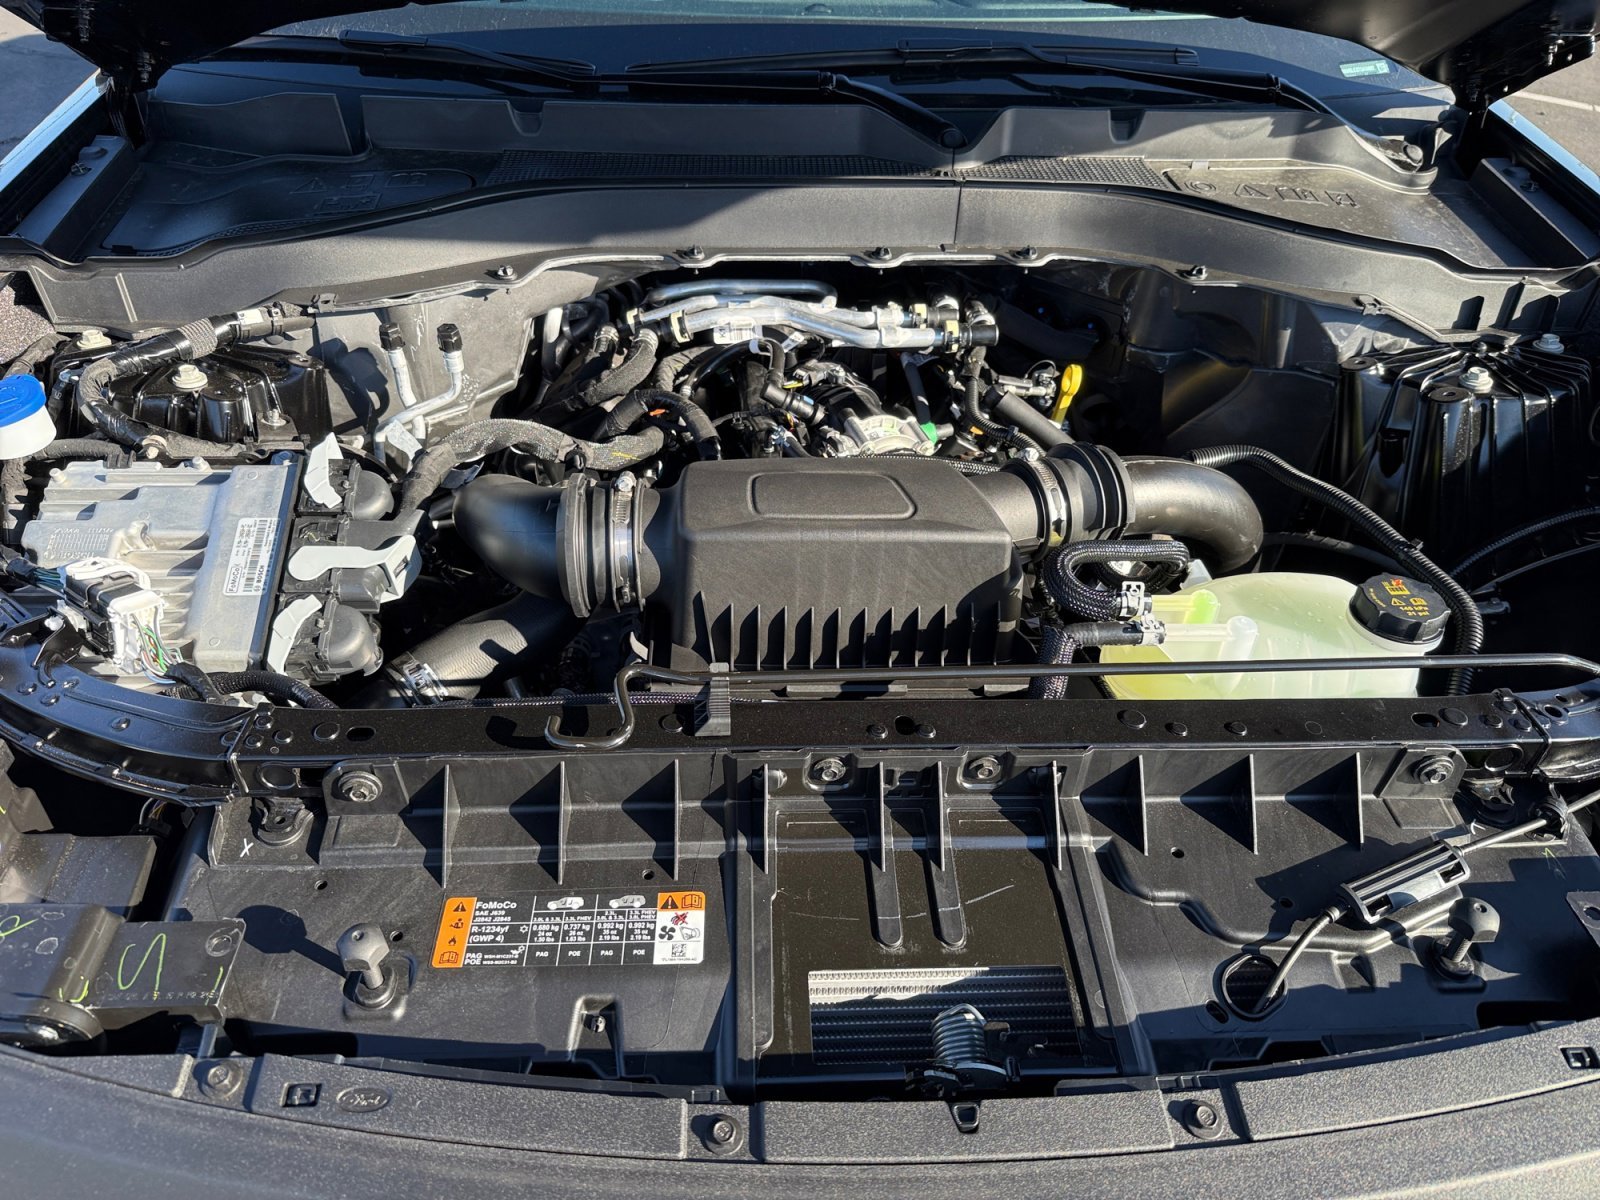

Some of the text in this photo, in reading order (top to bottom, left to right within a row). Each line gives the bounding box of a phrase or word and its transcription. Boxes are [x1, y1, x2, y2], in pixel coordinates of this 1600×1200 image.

[228, 568, 240, 592] FoMoCo
[256, 565, 265, 584] BOSCH
[476, 901, 517, 909] FoMoCo
